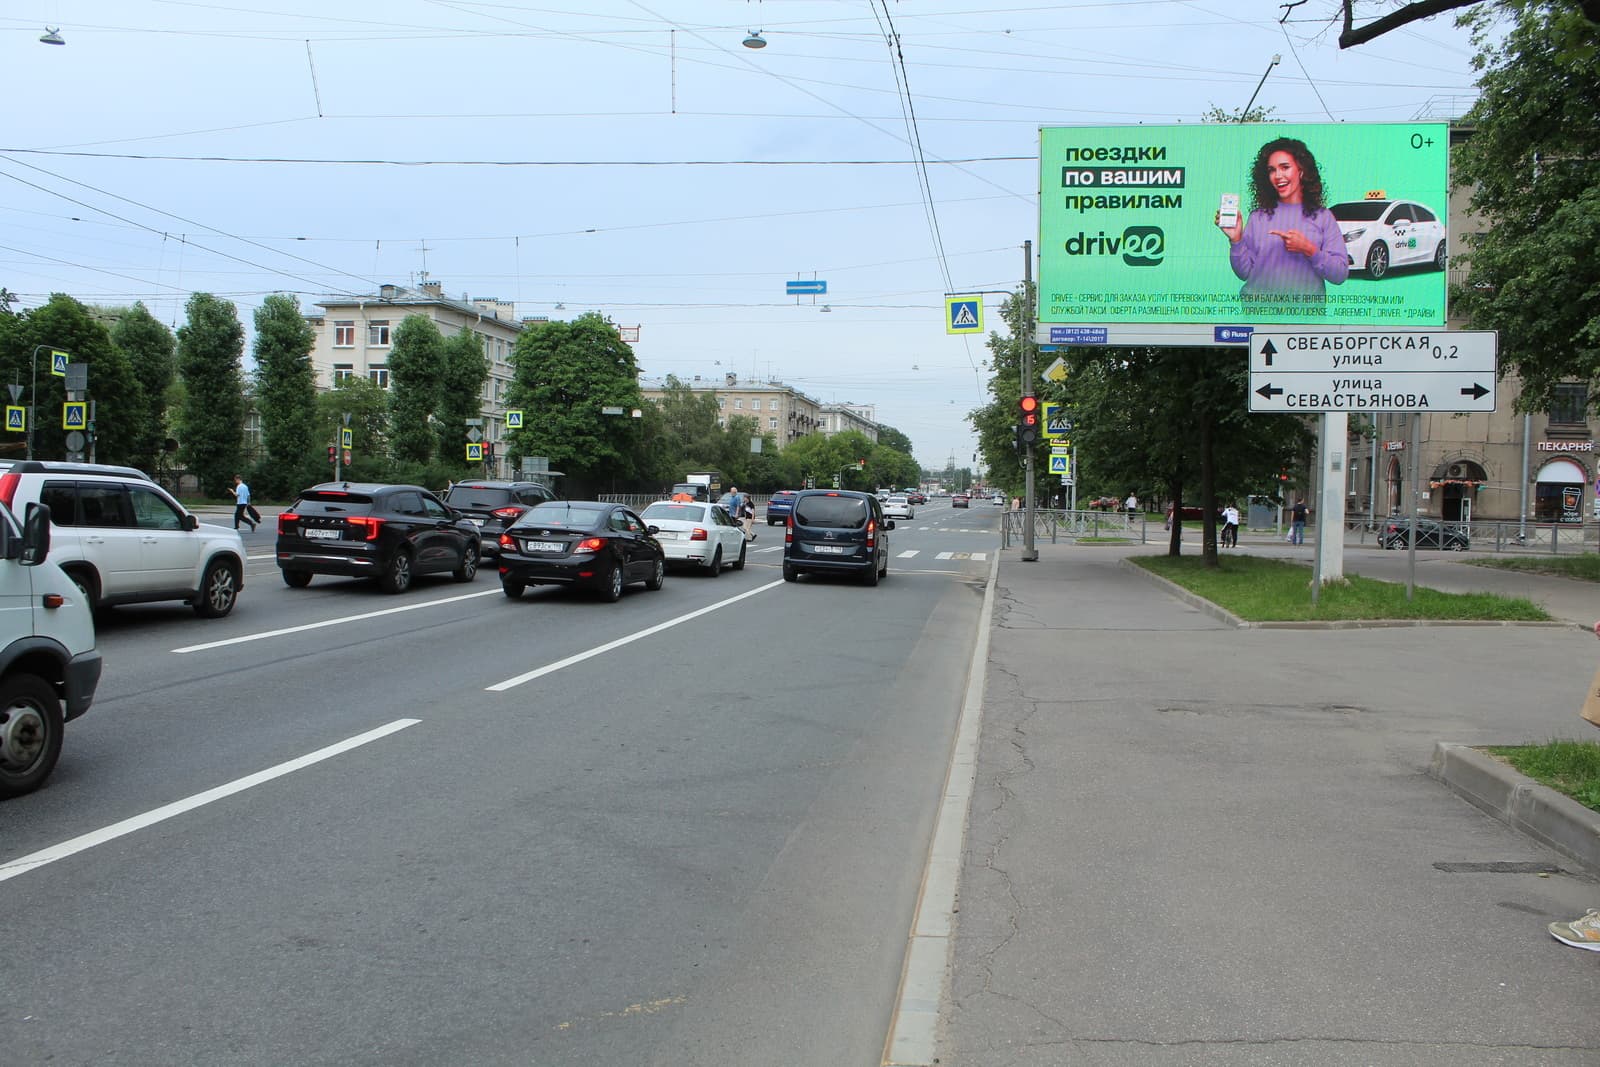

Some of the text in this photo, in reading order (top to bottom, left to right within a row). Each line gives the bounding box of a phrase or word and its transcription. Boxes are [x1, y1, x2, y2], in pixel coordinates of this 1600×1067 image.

[1410, 133, 1434, 149] 0+
[1066, 146, 1167, 164] поездки
[1065, 169, 1181, 185] по вашим
[1065, 194, 1183, 214] правилам
[1065, 228, 1165, 264] drivee
[1286, 336, 1430, 350] СВЕАБОРГСКАЯ
[1432, 346, 1458, 360] 0,2
[1332, 354, 1383, 368] улица
[1332, 378, 1383, 392] улица
[1286, 394, 1429, 408] СЕВАСТЬЯНОВА
[1537, 442, 1592, 451] ПЕКАРНЯ
